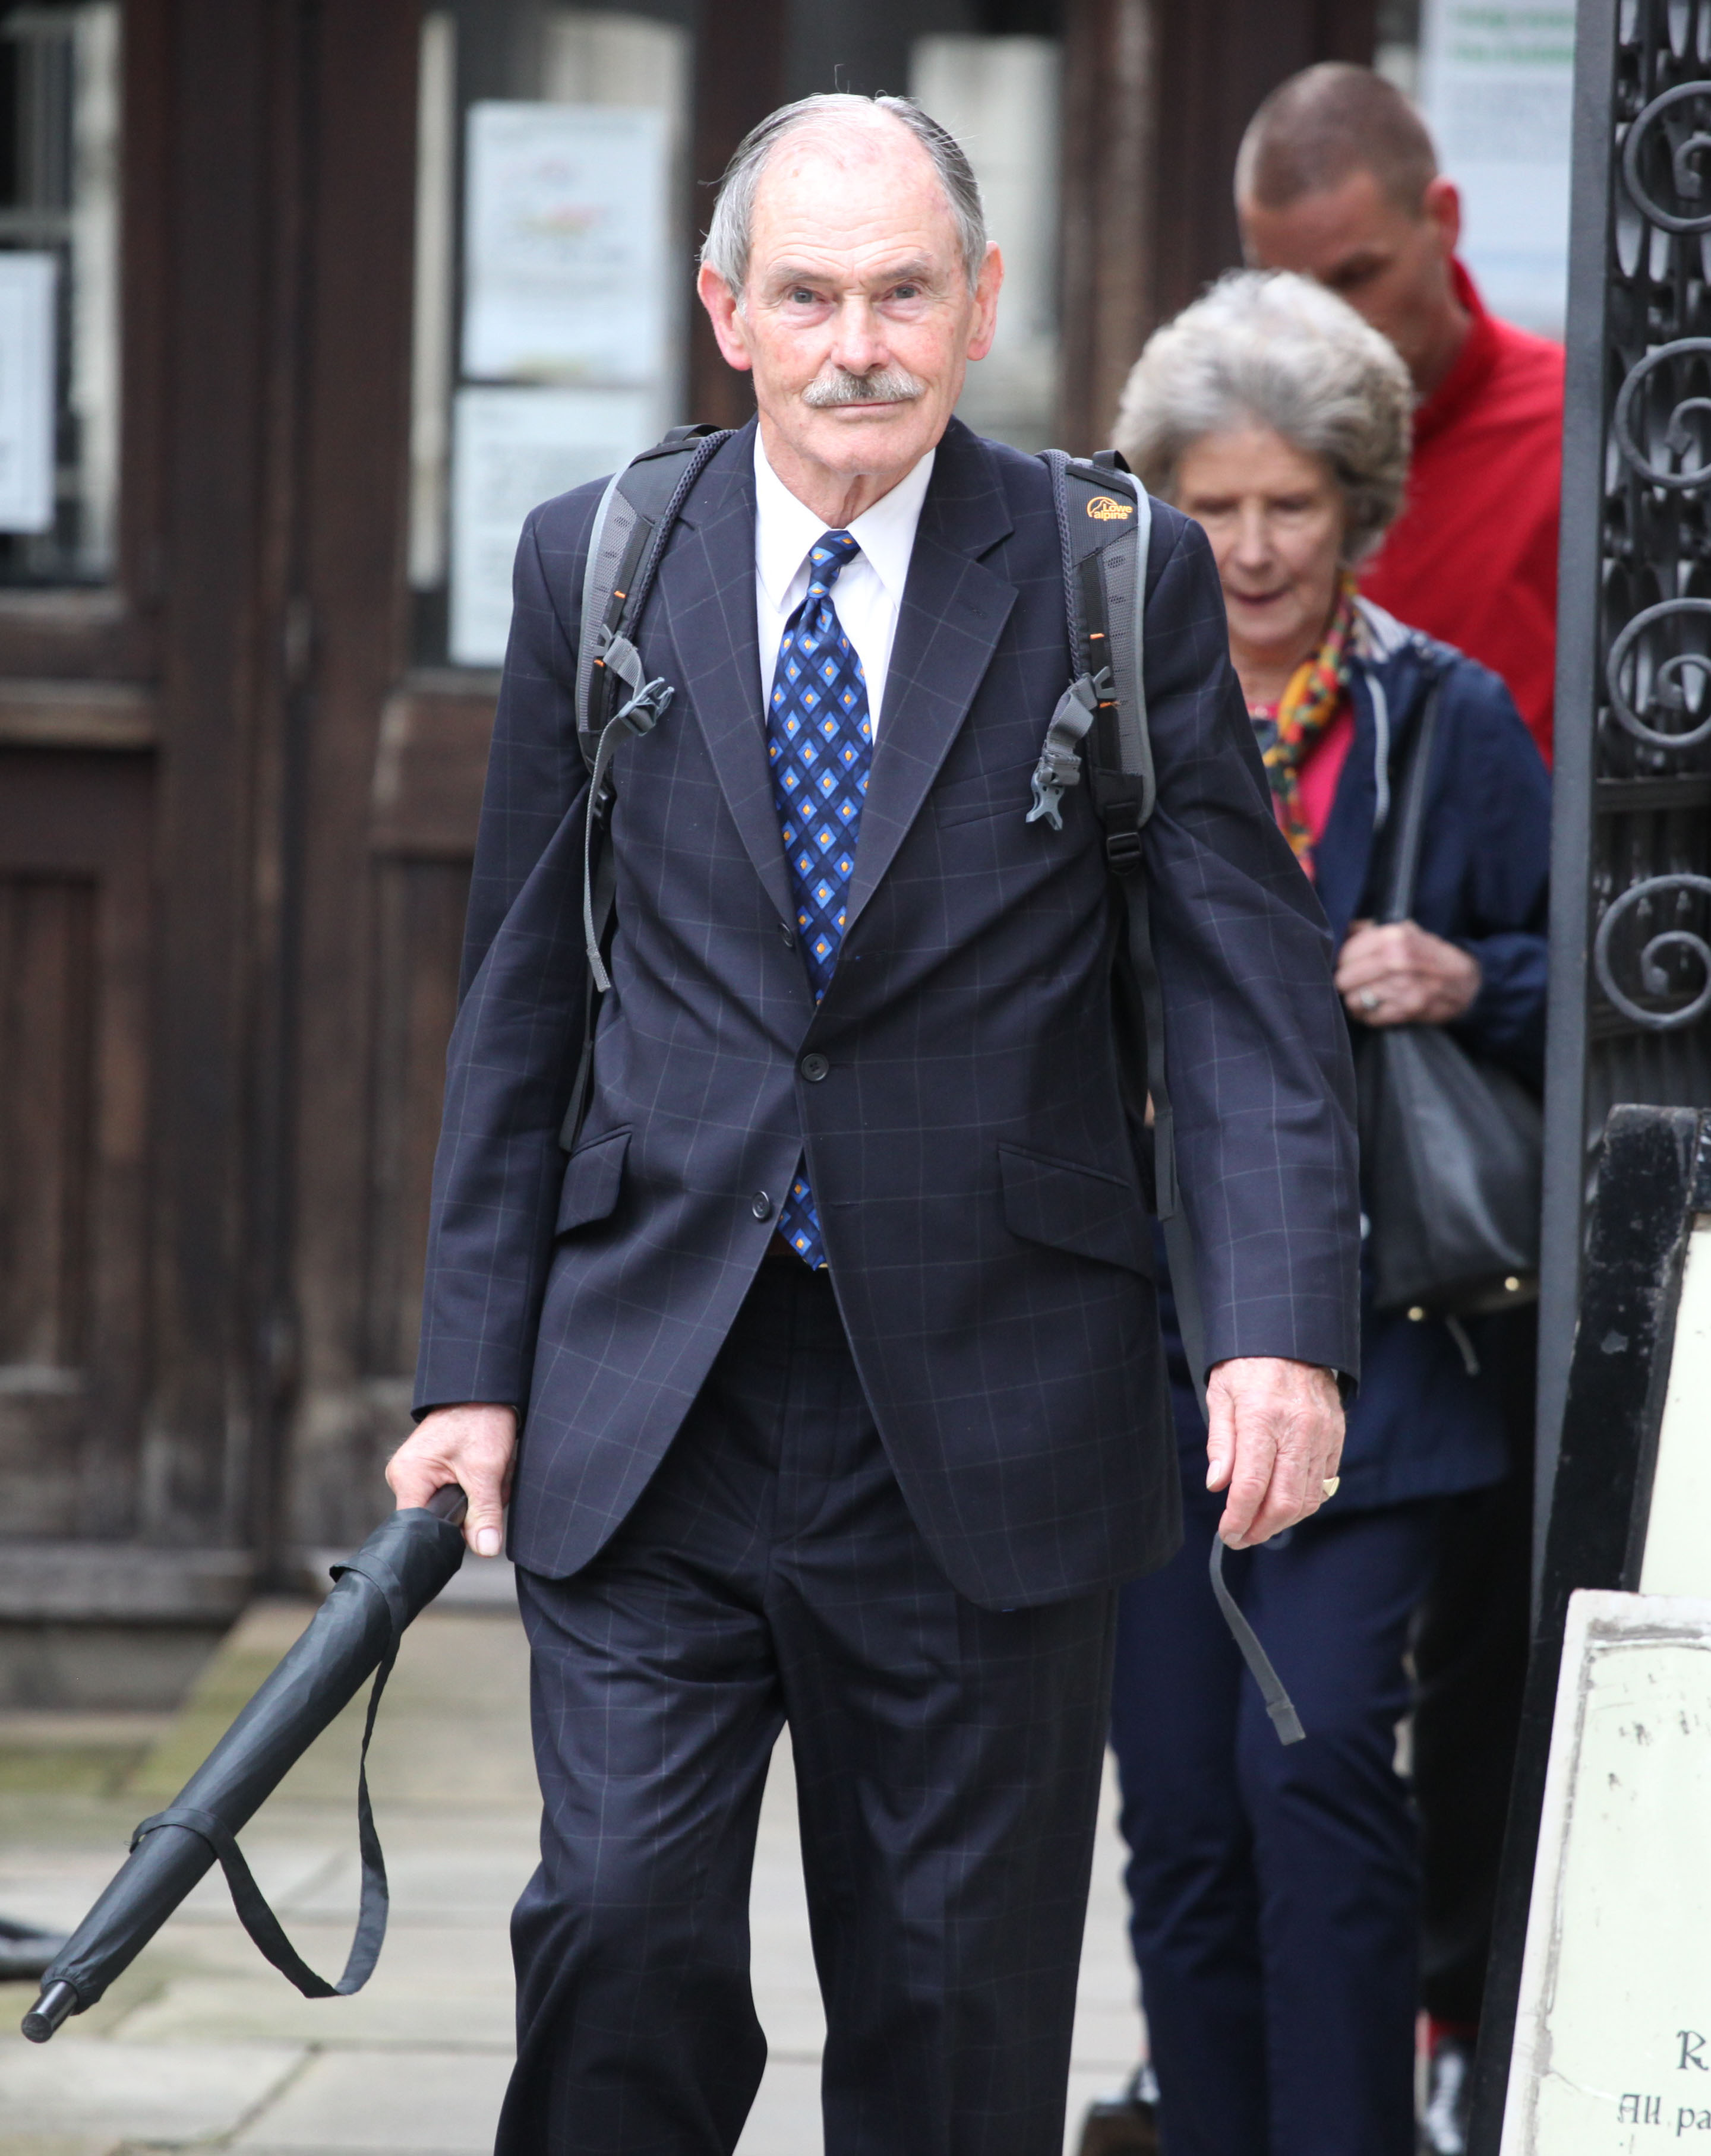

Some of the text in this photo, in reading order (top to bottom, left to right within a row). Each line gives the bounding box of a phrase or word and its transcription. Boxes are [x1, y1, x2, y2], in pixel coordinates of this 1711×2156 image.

[1103, 504, 1133, 513] Lowe
[1094, 510, 1128, 521] alpine
[1617, 2092, 1661, 2125] All
